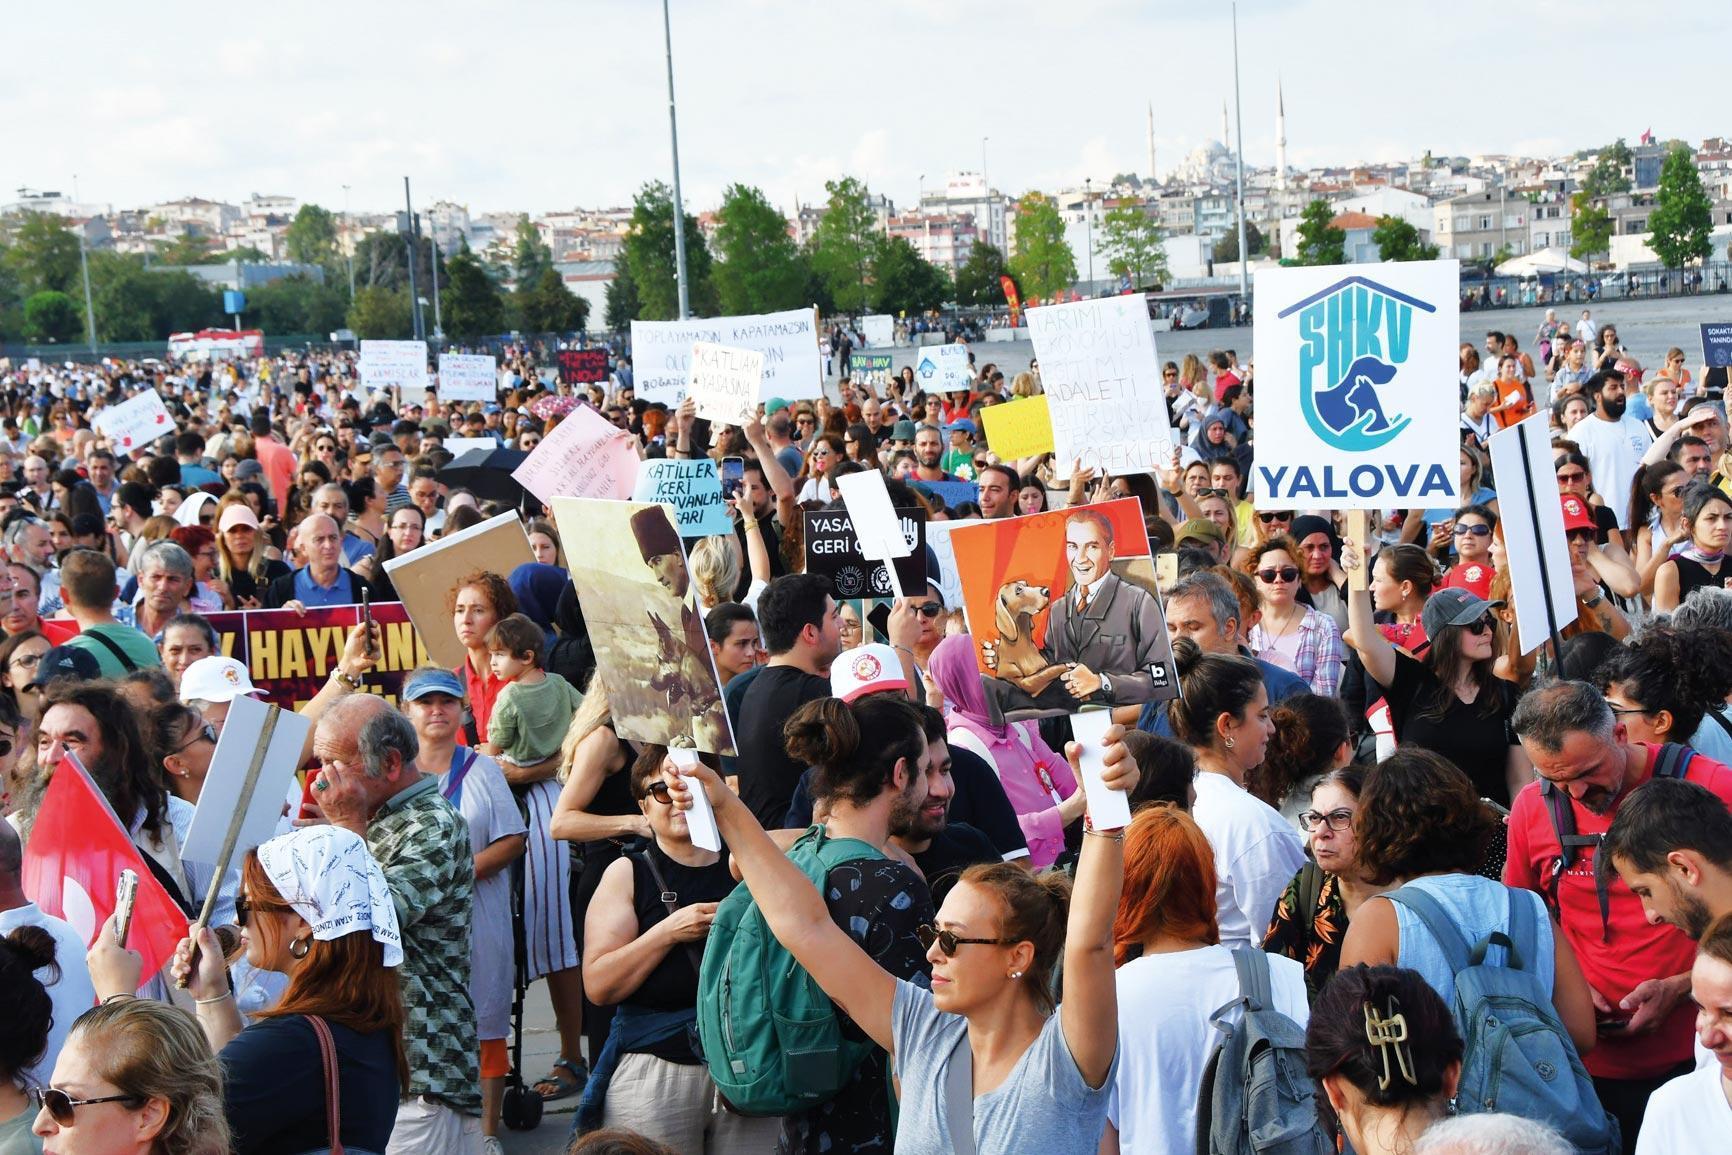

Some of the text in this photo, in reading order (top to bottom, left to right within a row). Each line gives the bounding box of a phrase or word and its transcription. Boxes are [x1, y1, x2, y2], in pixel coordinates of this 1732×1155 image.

[733, 320, 810, 342] KAPATAMAZSIN
[1047, 373, 1138, 402] ADALETİ
[646, 461, 715, 480] KATİLLER
[1258, 464, 1456, 498] YALOVA
[812, 536, 850, 554] GERİ
[312, 914, 353, 934] ATAM İZİNDE
